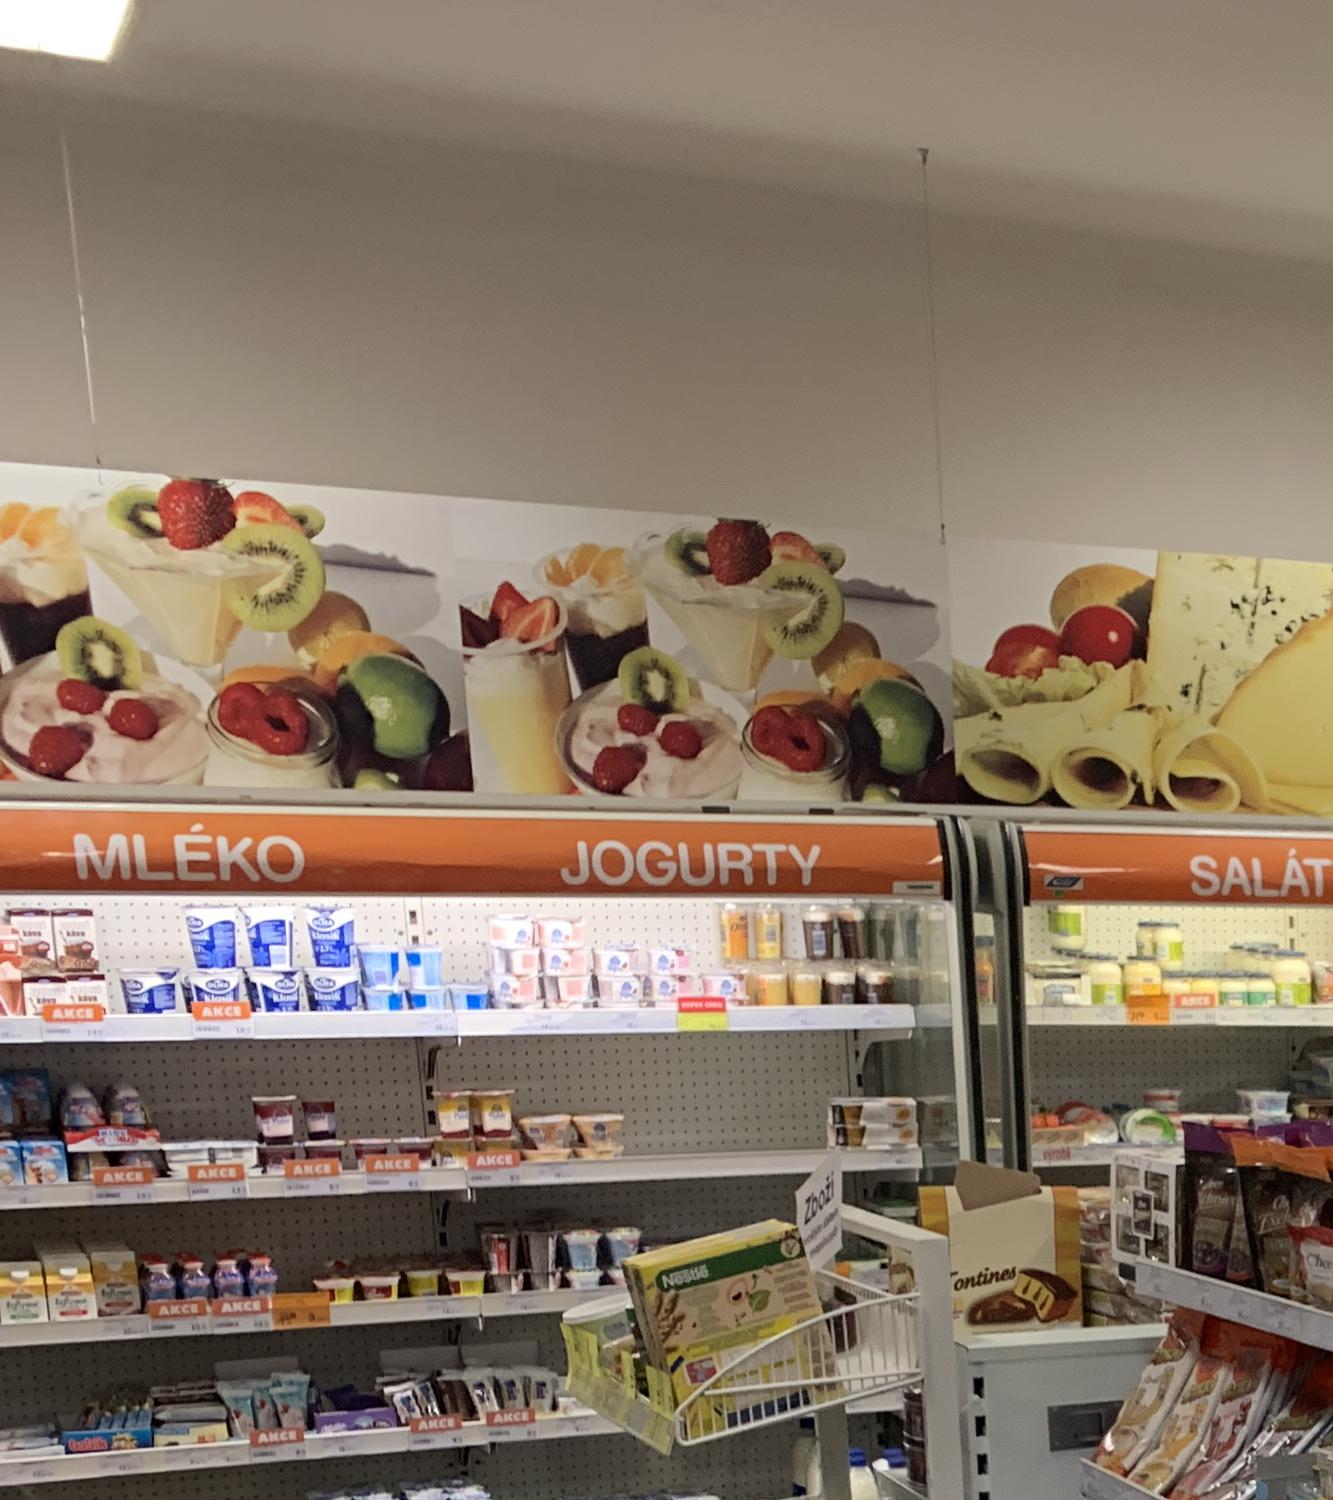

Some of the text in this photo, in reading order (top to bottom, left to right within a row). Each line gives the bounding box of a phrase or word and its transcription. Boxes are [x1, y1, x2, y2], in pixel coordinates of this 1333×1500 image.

[74, 824, 304, 882] MLÉKO
[561, 840, 820, 886] JOGURTY
[52, 1007, 95, 1020] AKCE
[201, 1005, 243, 1018] AKCE
[373, 1158, 412, 1172] AKCE
[476, 1154, 515, 1168] AKCE
[102, 1170, 145, 1184] AKCE
[198, 1167, 237, 1181] AKCE
[293, 1163, 332, 1177] AKCE
[661, 1266, 709, 1288] Nestlé
[158, 1303, 200, 1316] AKCE
[221, 1299, 262, 1312] AKCE
[417, 1417, 459, 1431] AKCE
[492, 1411, 532, 1424] AKCE
[257, 1431, 297, 1442] AKCE
